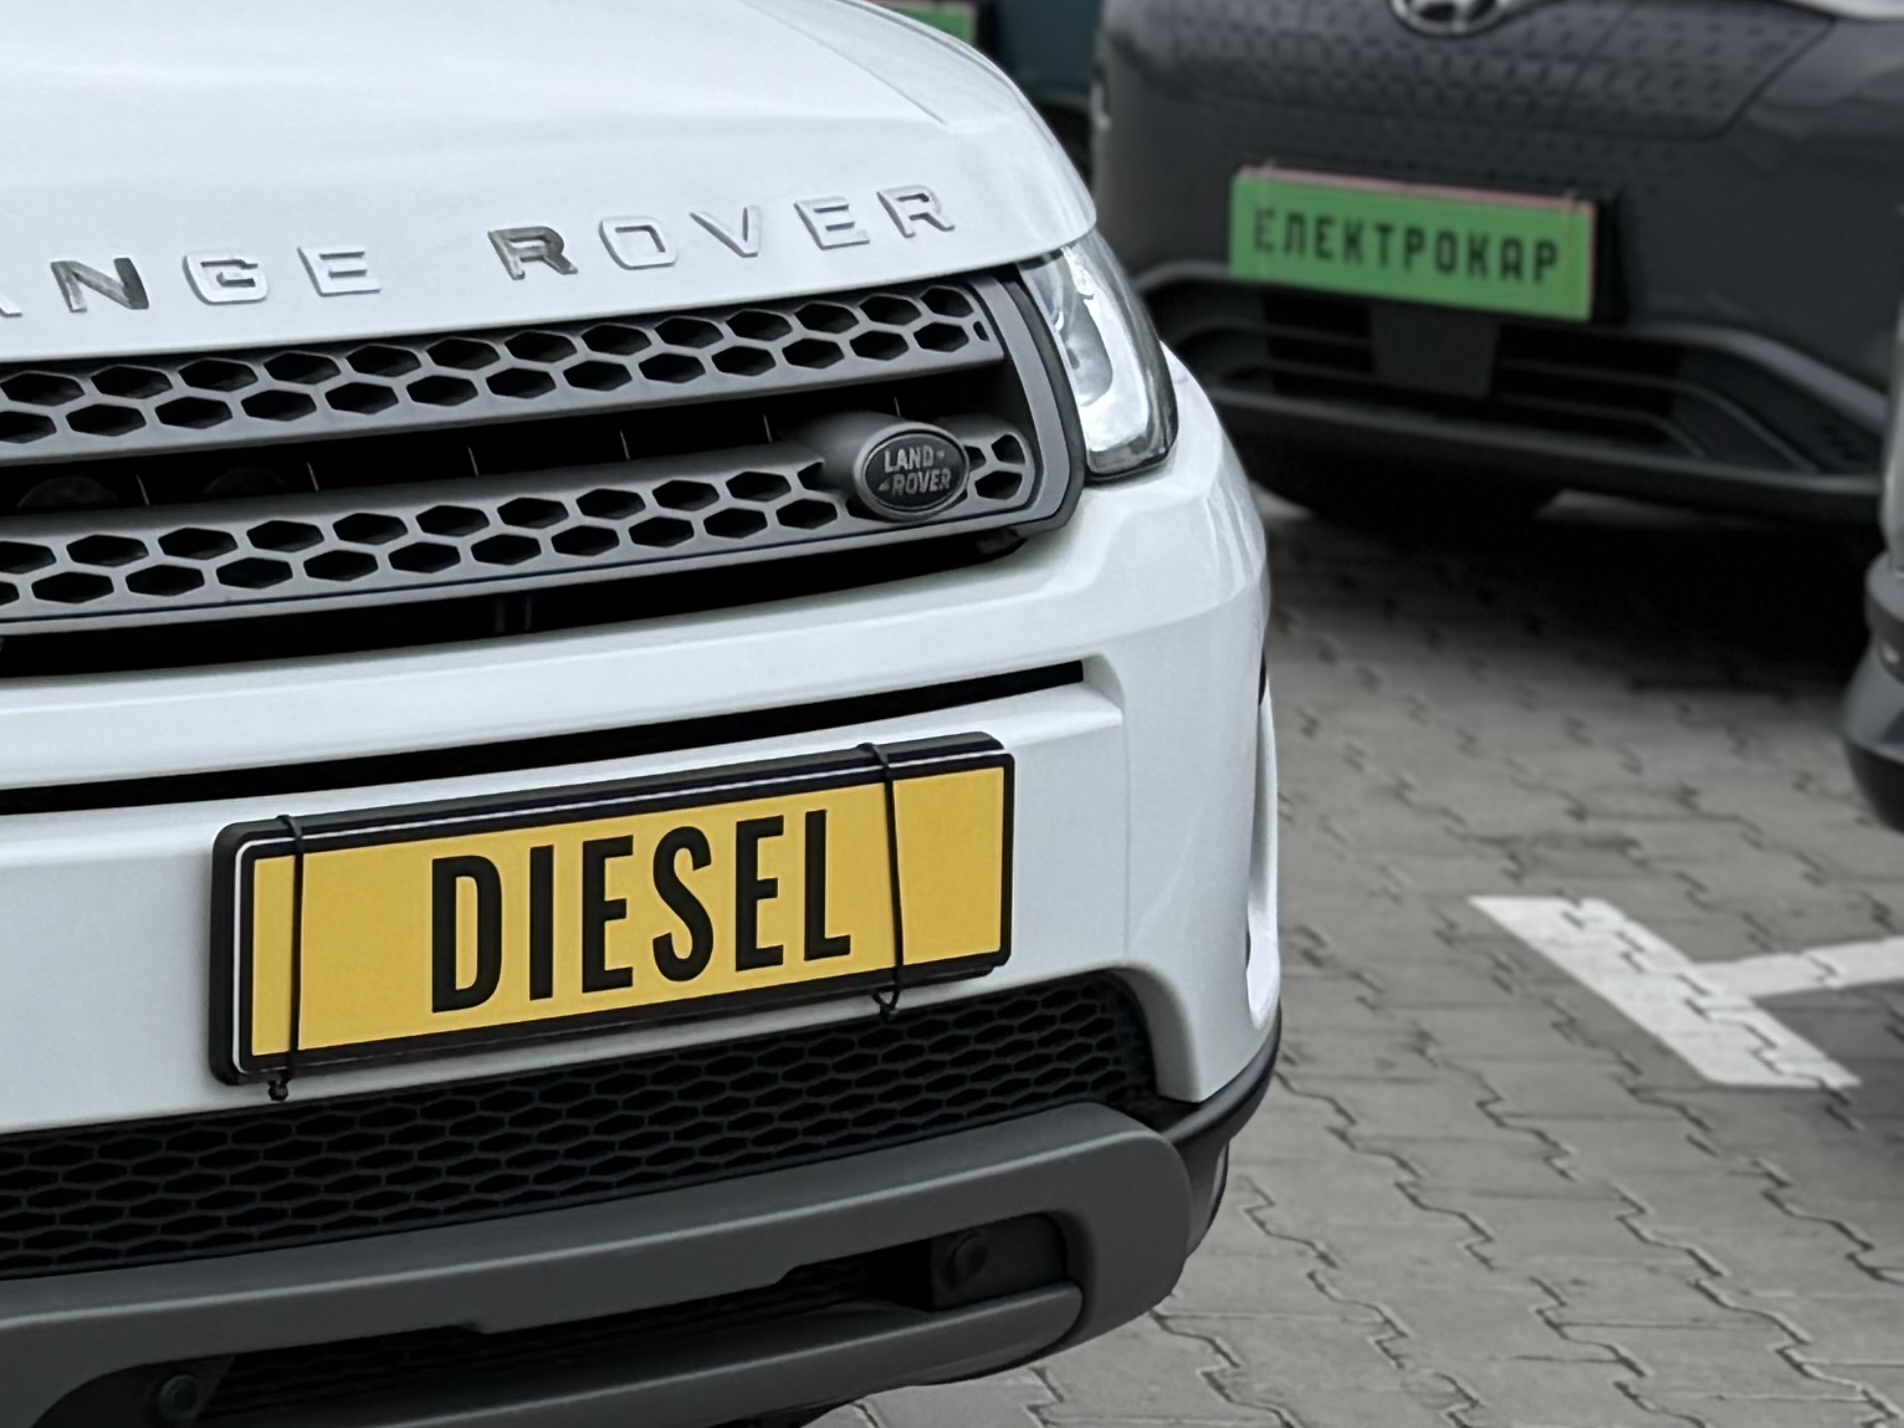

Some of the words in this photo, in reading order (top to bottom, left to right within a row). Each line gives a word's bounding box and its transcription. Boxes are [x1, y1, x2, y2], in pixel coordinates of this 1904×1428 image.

[488, 183, 956, 280] ROVER
[1254, 205, 1560, 285] ЕЛЕКТРОКАР
[884, 445, 934, 472] LAND
[891, 468, 951, 496] ROVER
[431, 809, 852, 1014] DIESEL
